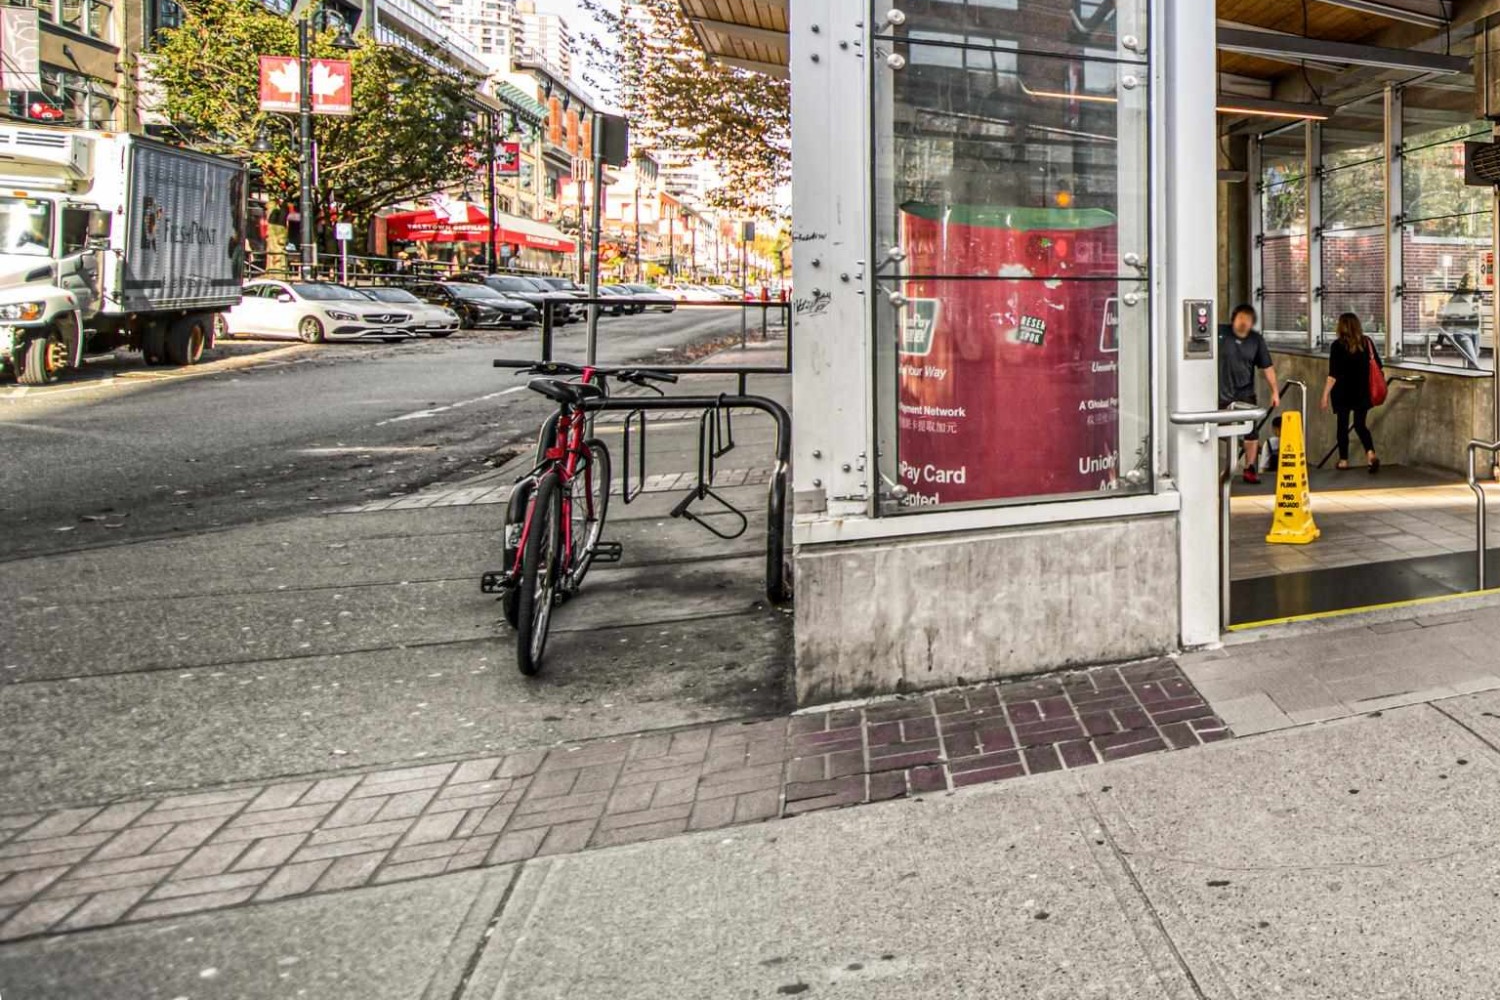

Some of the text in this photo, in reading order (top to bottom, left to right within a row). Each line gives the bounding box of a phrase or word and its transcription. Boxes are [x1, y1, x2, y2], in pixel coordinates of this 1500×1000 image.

[924, 366, 947, 380] Way
[924, 405, 967, 418] Network
[1079, 400, 1087, 411] A
[923, 464, 967, 484] Card
[1282, 493, 1295, 501] PISO
